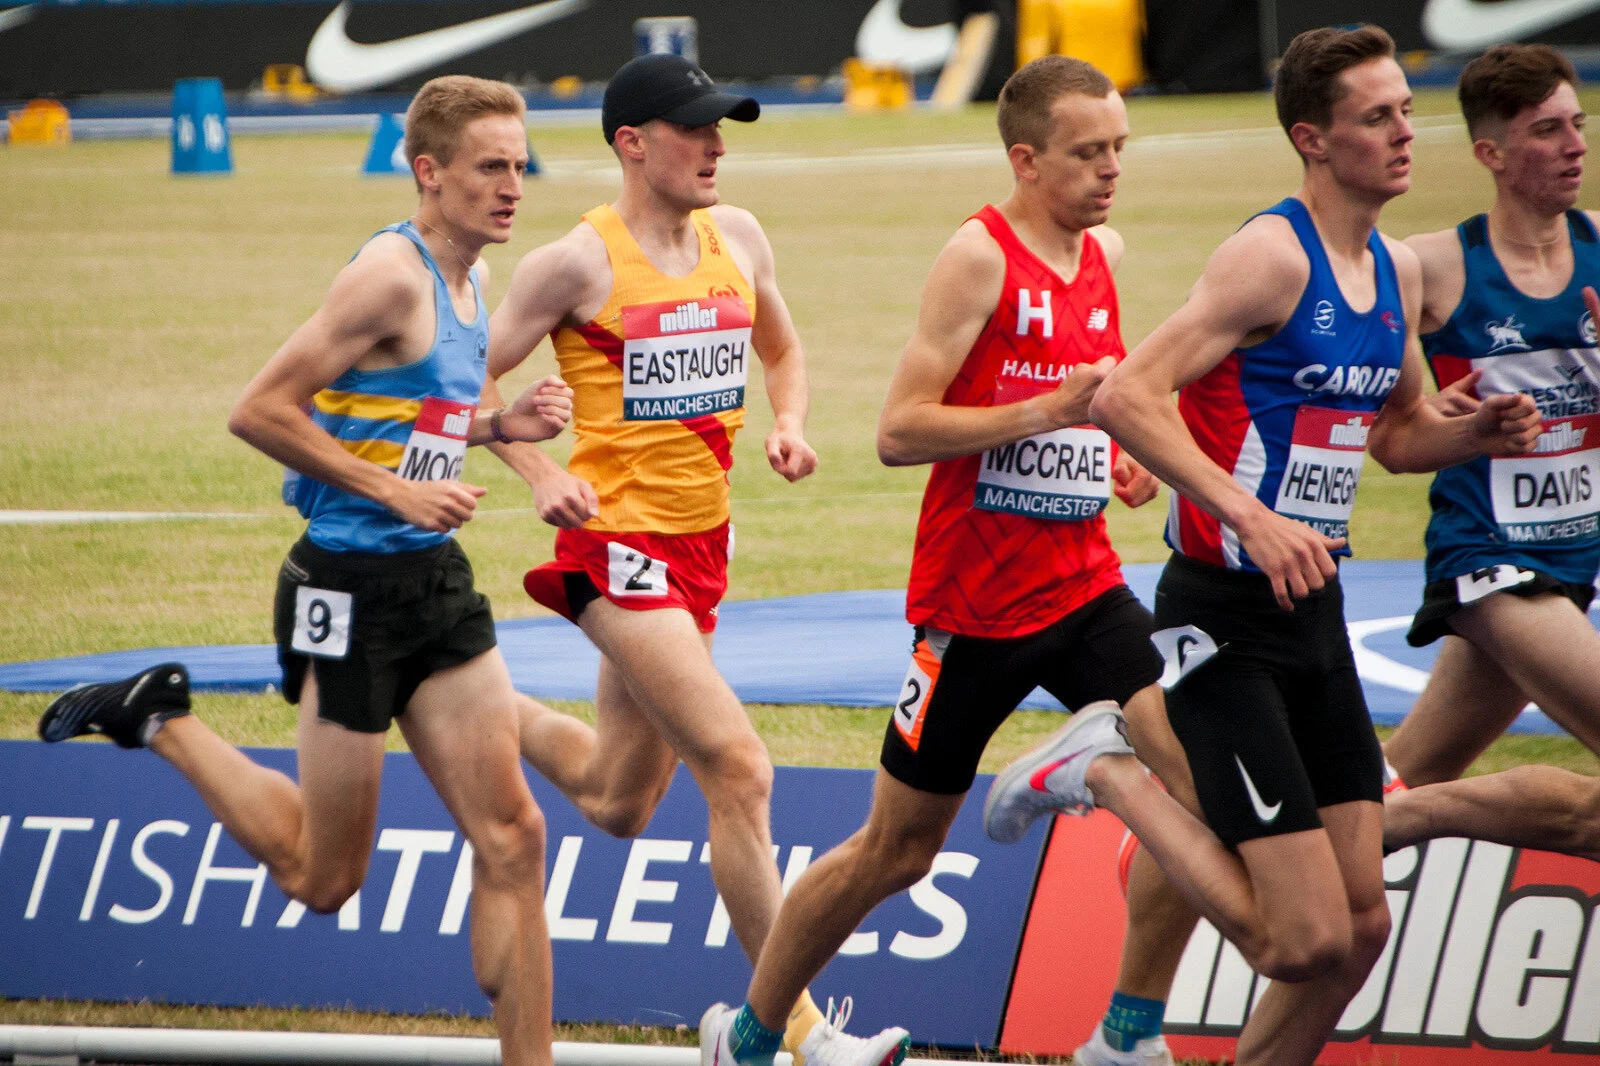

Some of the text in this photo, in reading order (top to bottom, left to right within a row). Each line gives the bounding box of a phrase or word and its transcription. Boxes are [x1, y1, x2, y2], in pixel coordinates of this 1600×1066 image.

[659, 301, 718, 333] müller
[1016, 288, 1053, 337] H
[629, 341, 745, 385] EASTAUGH
[1001, 359, 1074, 381] HALLA
[633, 389, 738, 417] MANCHESTER
[1519, 381, 1598, 403] ESTON
[986, 439, 1105, 482] MCCRAE
[983, 487, 1100, 517] MANCHESTER
[1513, 464, 1593, 508] DAVIS
[1506, 516, 1599, 542] MANCHESTER
[625, 552, 652, 590] 2
[307, 598, 332, 644] 9
[899, 677, 921, 720] 2
